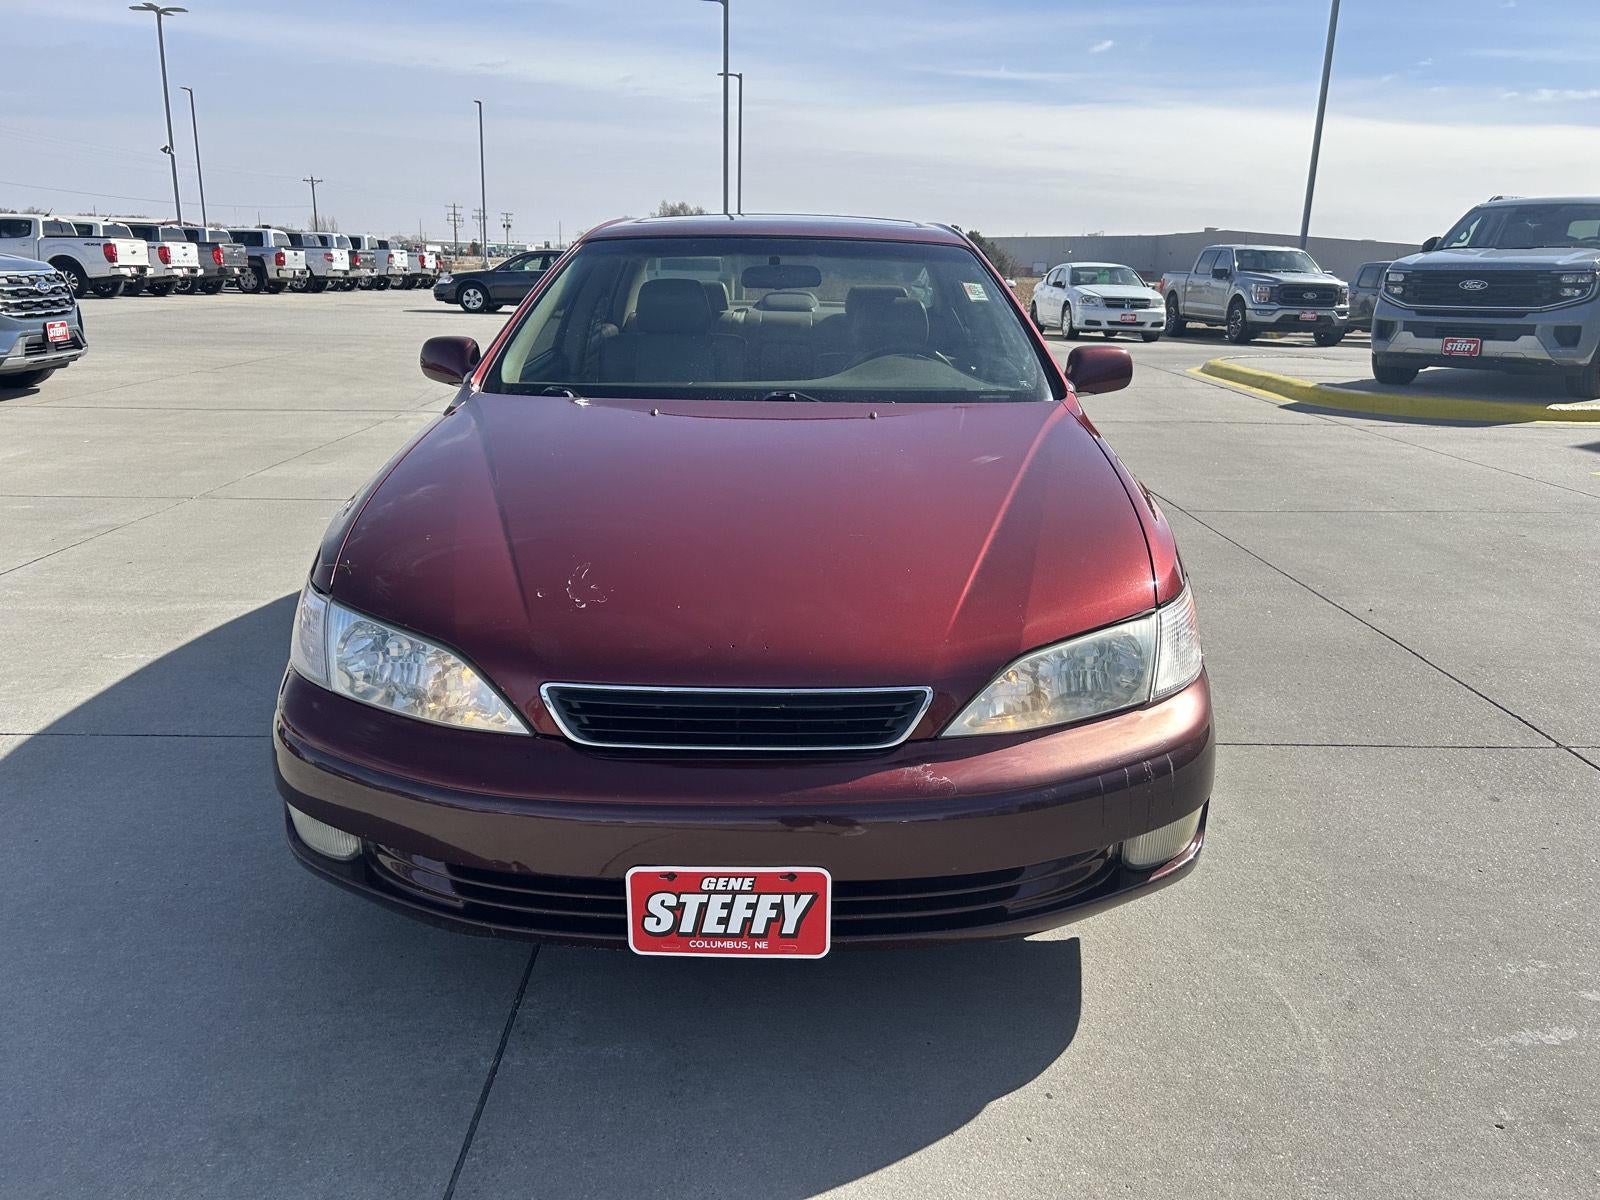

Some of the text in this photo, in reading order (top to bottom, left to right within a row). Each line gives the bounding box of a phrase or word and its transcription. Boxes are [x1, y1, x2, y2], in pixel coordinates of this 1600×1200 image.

[1445, 342, 1477, 352] STEFFY
[700, 876, 756, 892] GENE
[643, 892, 817, 938] STEFFY
[689, 940, 769, 950] COLUMBUS, NE
